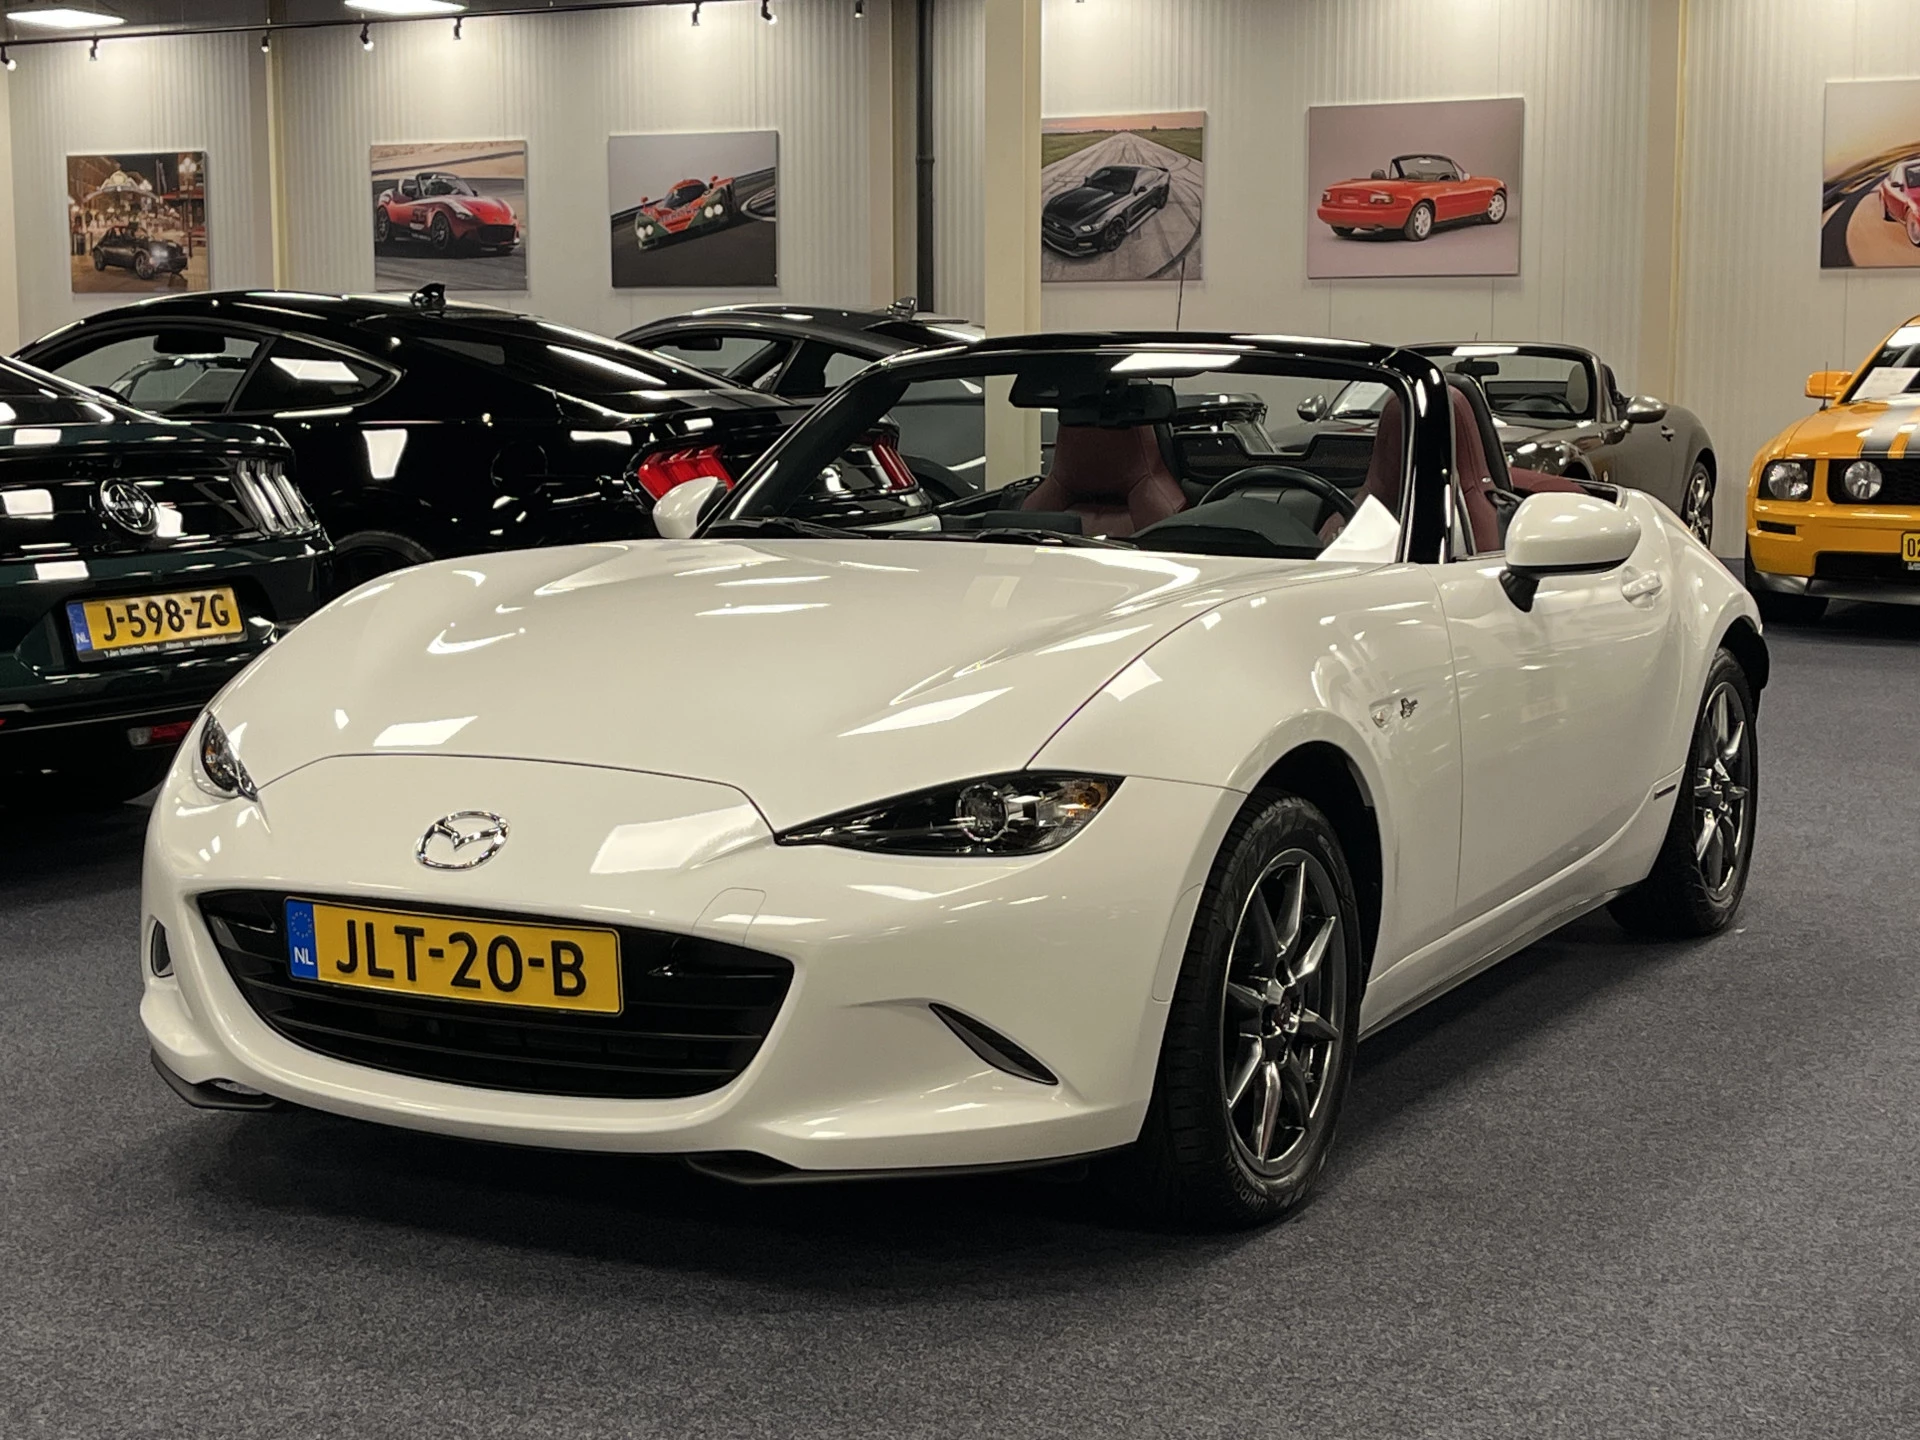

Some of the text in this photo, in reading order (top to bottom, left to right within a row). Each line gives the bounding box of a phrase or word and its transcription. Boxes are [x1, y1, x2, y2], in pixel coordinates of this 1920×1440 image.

[104, 594, 230, 641] J-598-ZG
[76, 633, 89, 643] NL
[294, 946, 314, 966] NL
[336, 919, 587, 998] JLT-20-B
